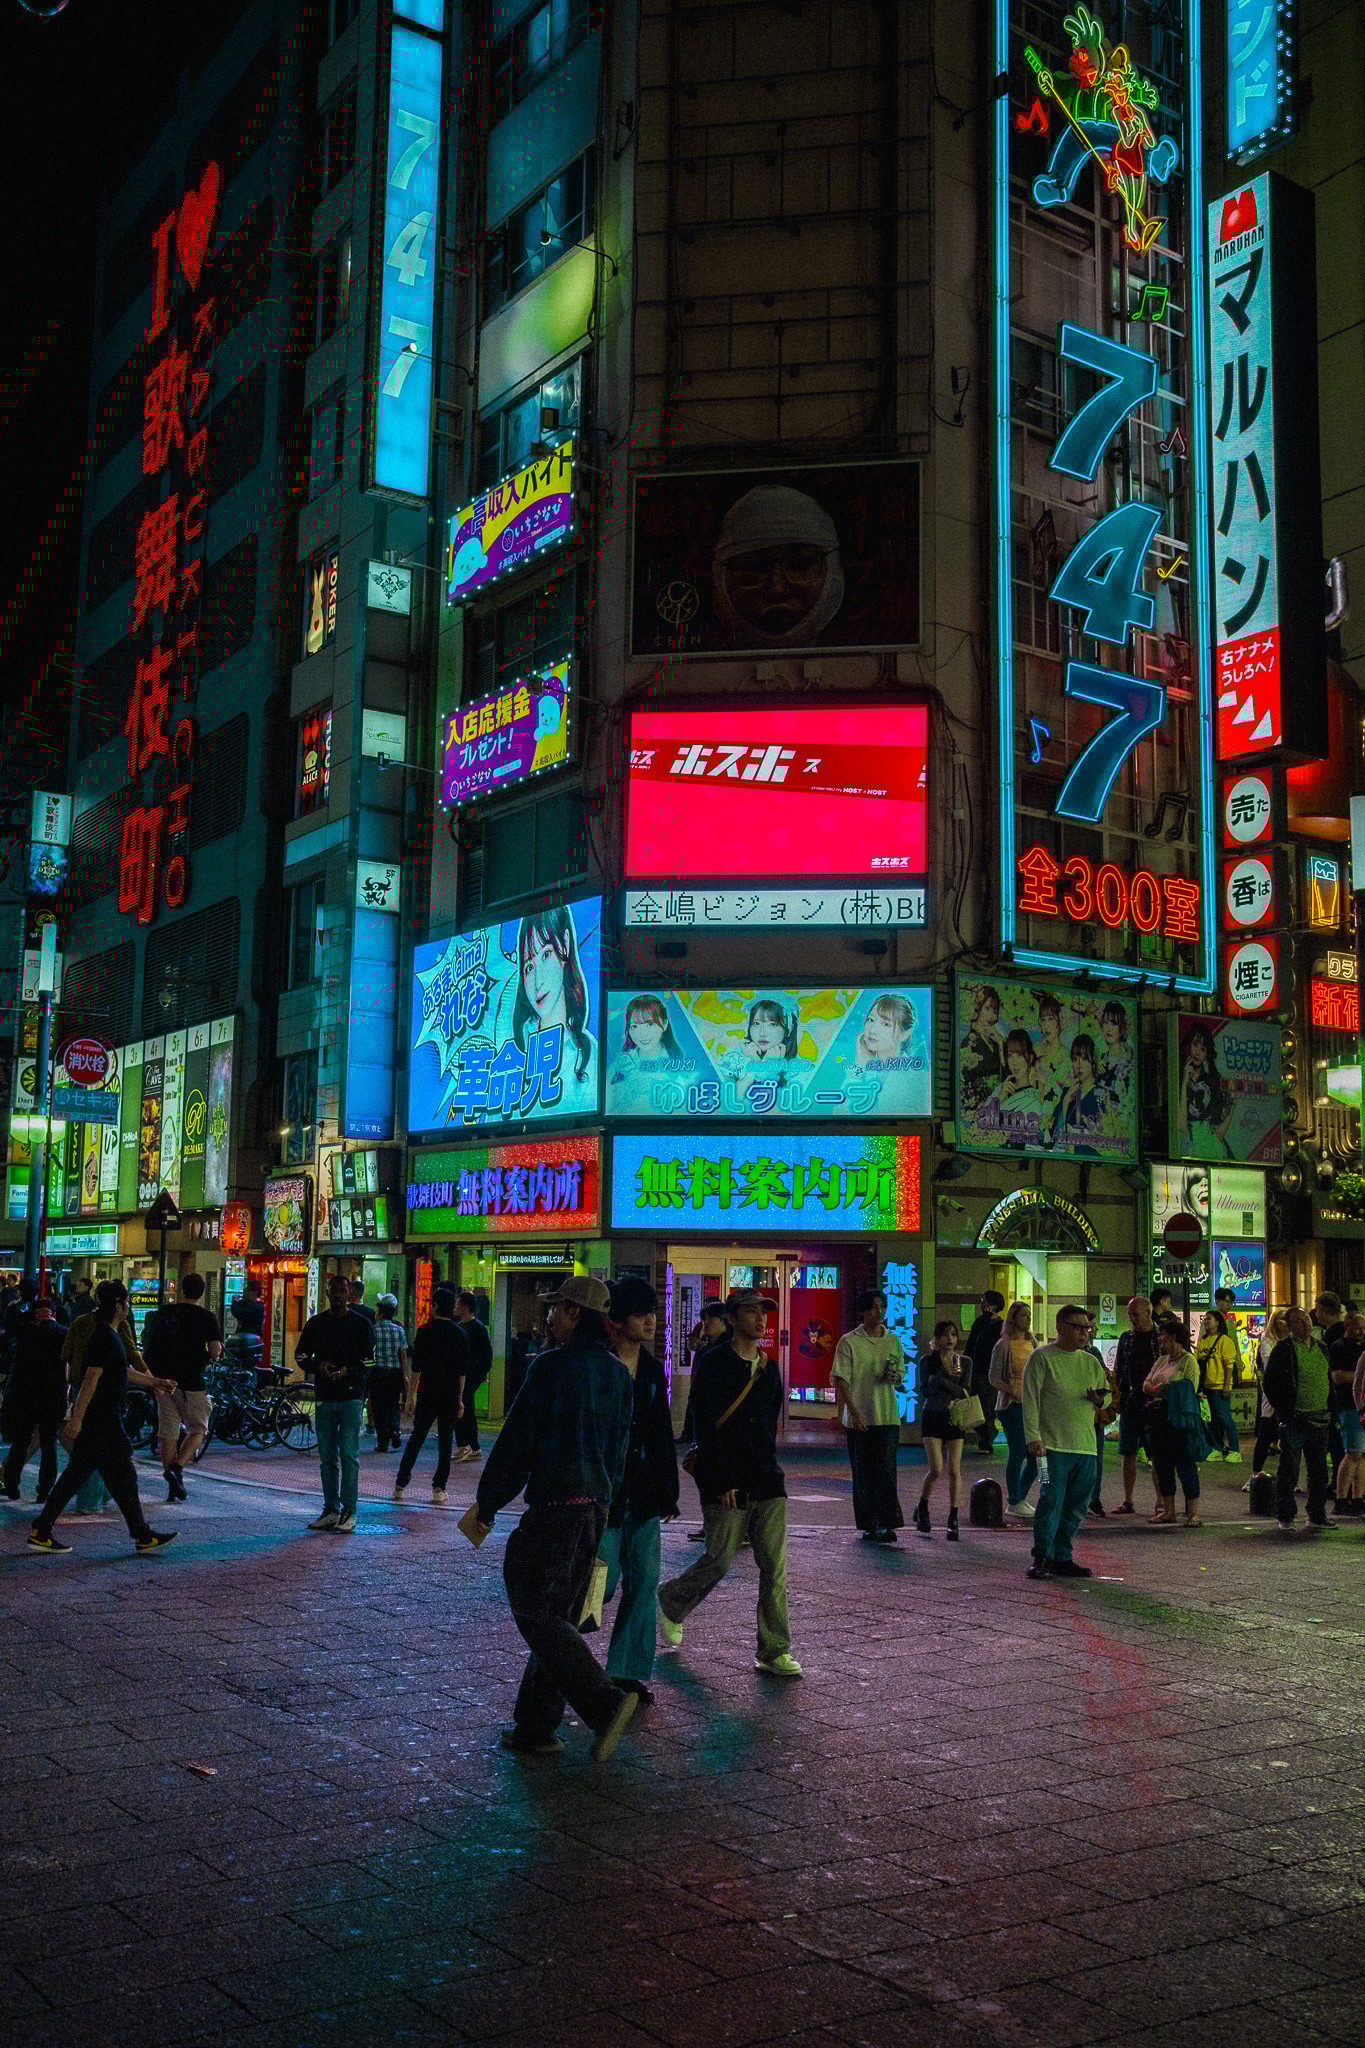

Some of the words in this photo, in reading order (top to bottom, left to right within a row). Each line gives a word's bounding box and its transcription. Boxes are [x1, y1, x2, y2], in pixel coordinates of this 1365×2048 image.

[381, 108, 438, 399] 747
[1213, 223, 1266, 265] MARUHAN
[1212, 248, 1271, 638] マルハン
[1048, 320, 1166, 823] 747
[327, 555, 339, 634] POKER
[1221, 636, 1276, 667] 右ナナメ
[445, 686, 531, 751] 入店応援金
[321, 709, 333, 800] HOUSE
[302, 769, 318, 785] ALICE
[1016, 845, 1201, 944] 全300室
[439, 969, 488, 1042] れな
[1235, 990, 1269, 1001] CIGARETTE
[150, 1040, 158, 1057] 4F
[171, 1034, 180, 1053] 5F
[193, 1028, 203, 1047] 6F
[68, 1051, 106, 1073] 消火栓
[130, 1047, 138, 1064] 3F
[660, 1058, 697, 1071] YUKI
[885, 1057, 924, 1071] KIYO
[1225, 1054, 1272, 1076] コンセプト
[453, 1023, 564, 1119] 革命児
[17, 1096, 34, 1104] Dart
[976, 1096, 1041, 1133] alma
[1263, 1146, 1280, 1160] B1F
[11, 1189, 29, 1197] Fami
[455, 1160, 584, 1216] 無料案内所
[633, 1155, 897, 1211] 無料案内所
[1215, 1194, 1261, 1212] Ultimate
[985, 1191, 1046, 1243] KANESHIMA
[1052, 1193, 1099, 1249] BUILDING
[1152, 1245, 1167, 1258] 2F
[1251, 1290, 1263, 1300] 7F
